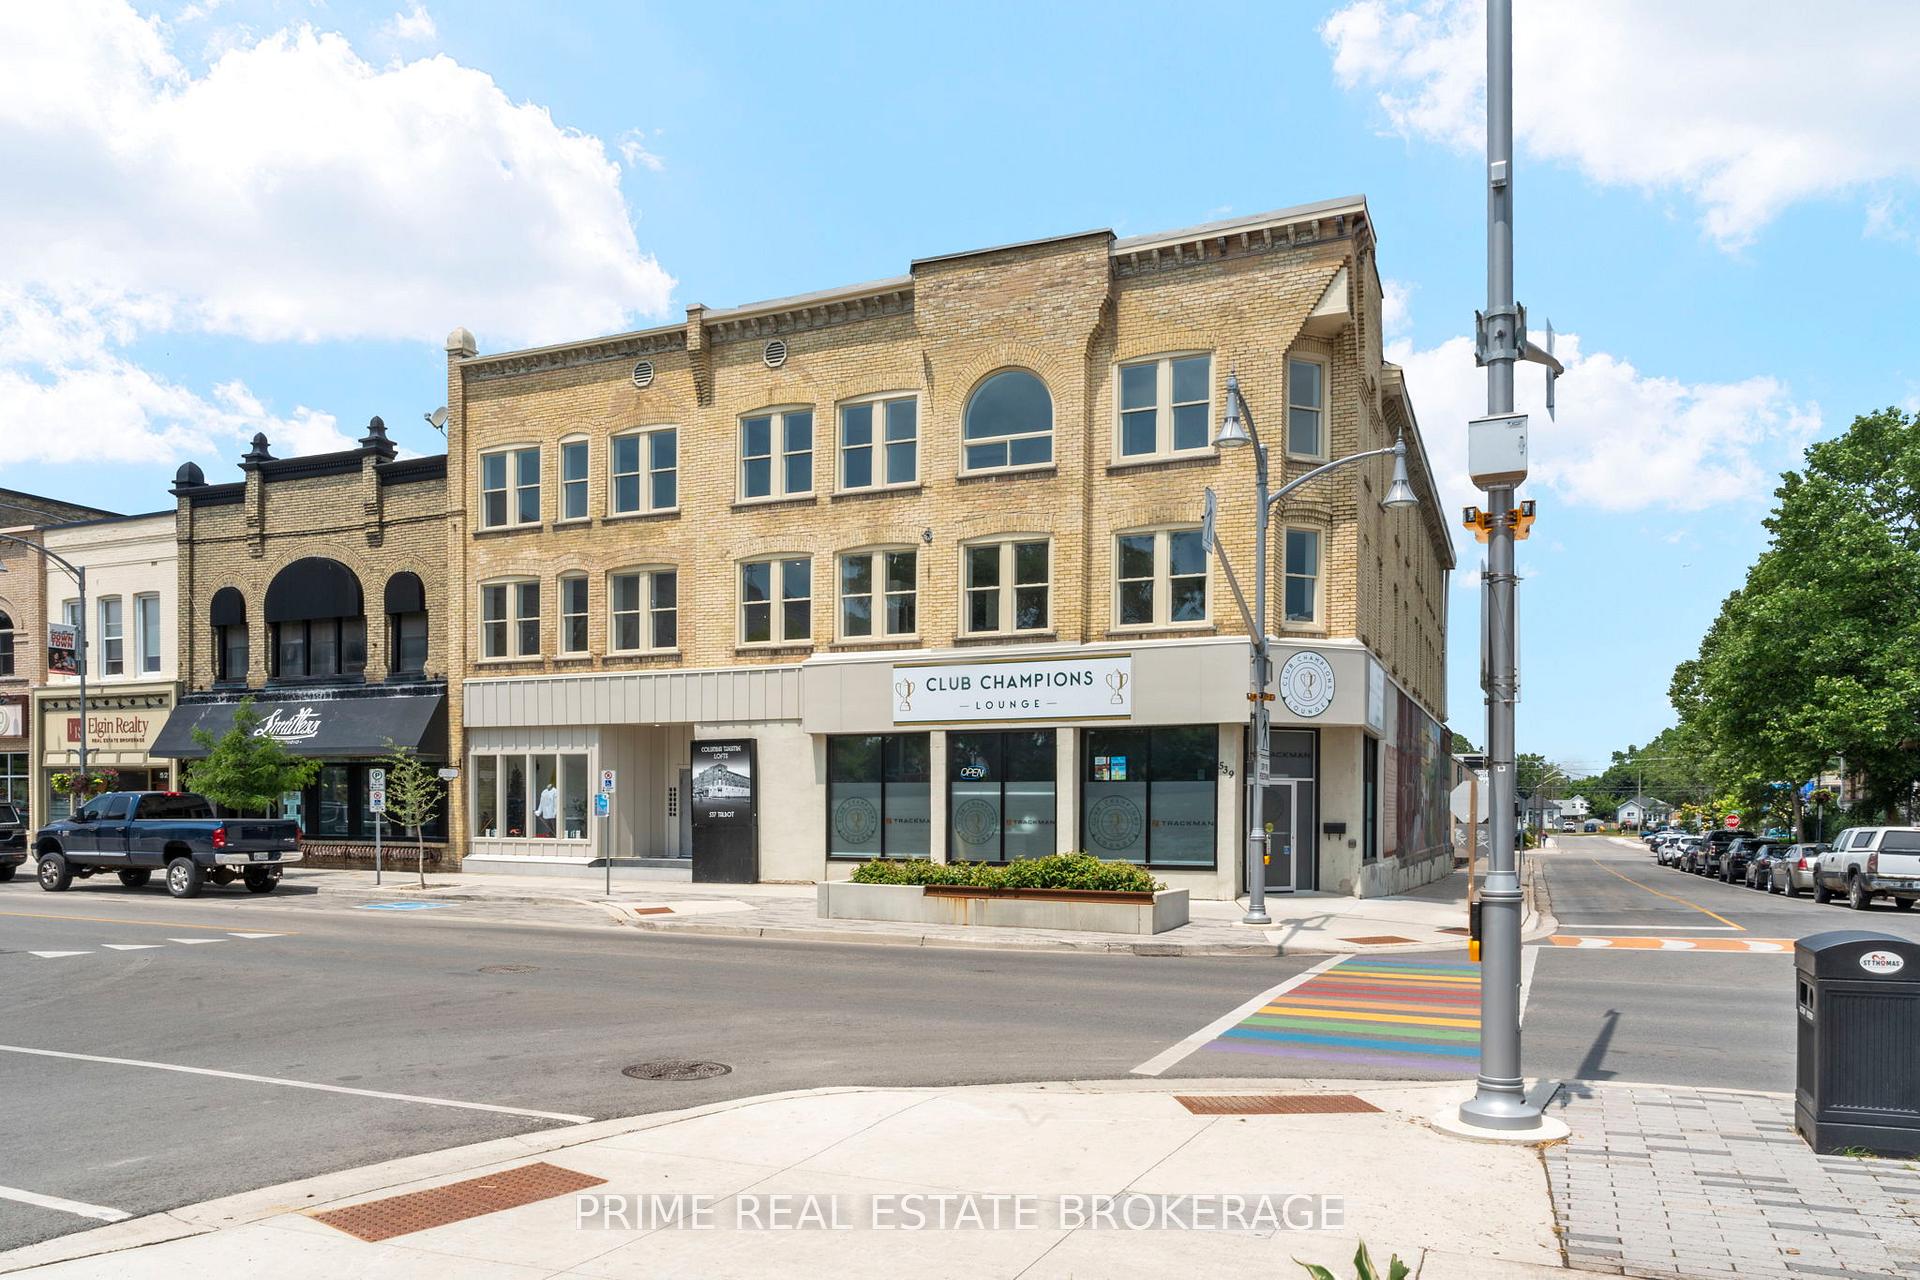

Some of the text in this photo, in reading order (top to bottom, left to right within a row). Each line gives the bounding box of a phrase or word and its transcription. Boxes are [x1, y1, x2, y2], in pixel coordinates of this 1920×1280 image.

[51, 633, 73, 641] DOWN
[51, 640, 73, 648] TOWN
[926, 671, 1094, 692] CLUB CHAMPIONS
[975, 699, 1041, 710] LOUNGE
[88, 716, 149, 737] Elgin Realty
[960, 767, 984, 777] OPEN
[1219, 761, 1235, 779] 539
